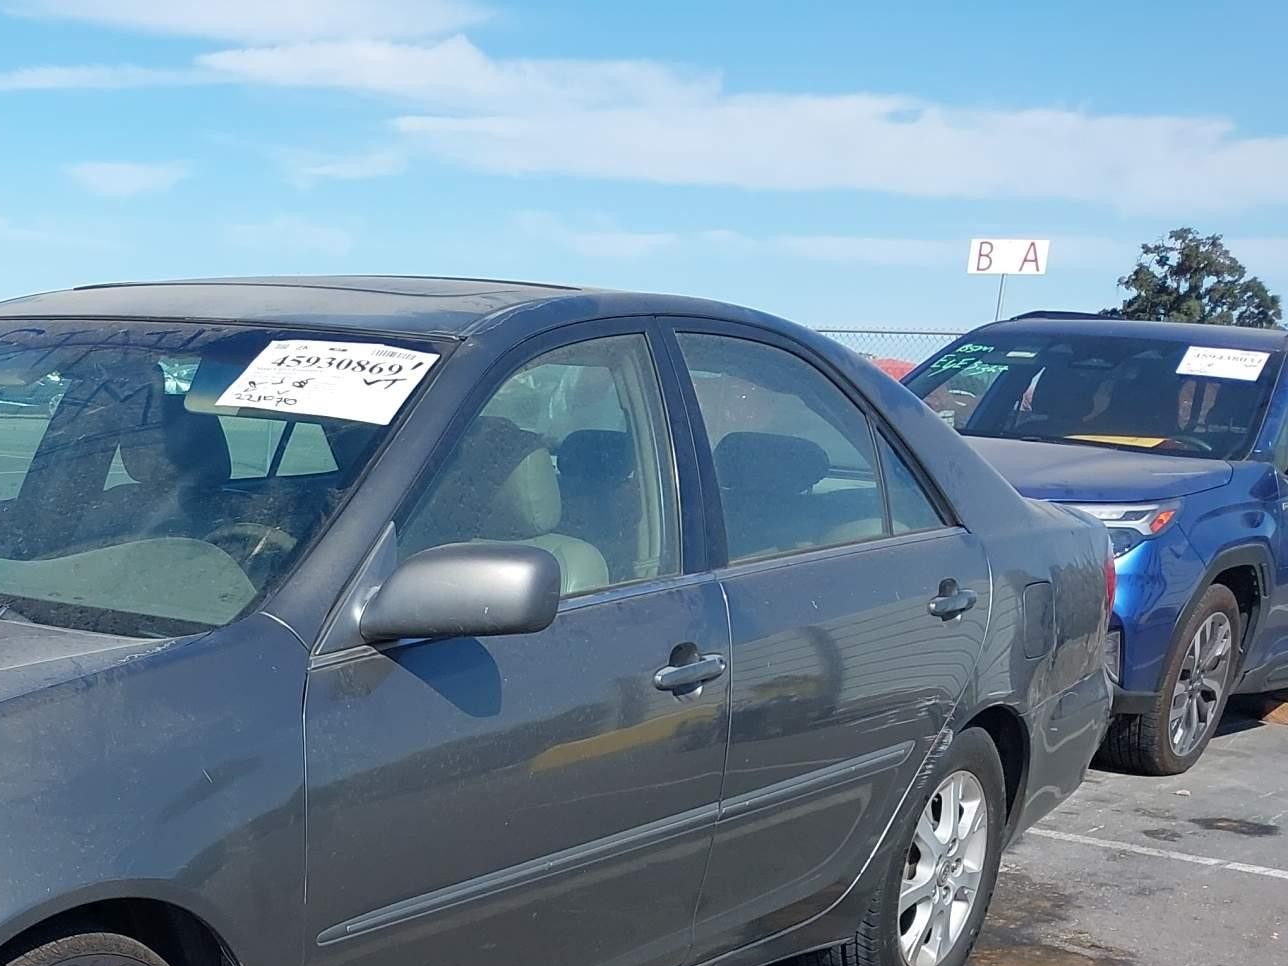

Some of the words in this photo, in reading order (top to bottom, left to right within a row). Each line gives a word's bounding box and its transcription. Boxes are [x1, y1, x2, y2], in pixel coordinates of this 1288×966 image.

[976, 241, 994, 272] B
[1019, 241, 1040, 272] A
[272, 355, 404, 377] 45930869
